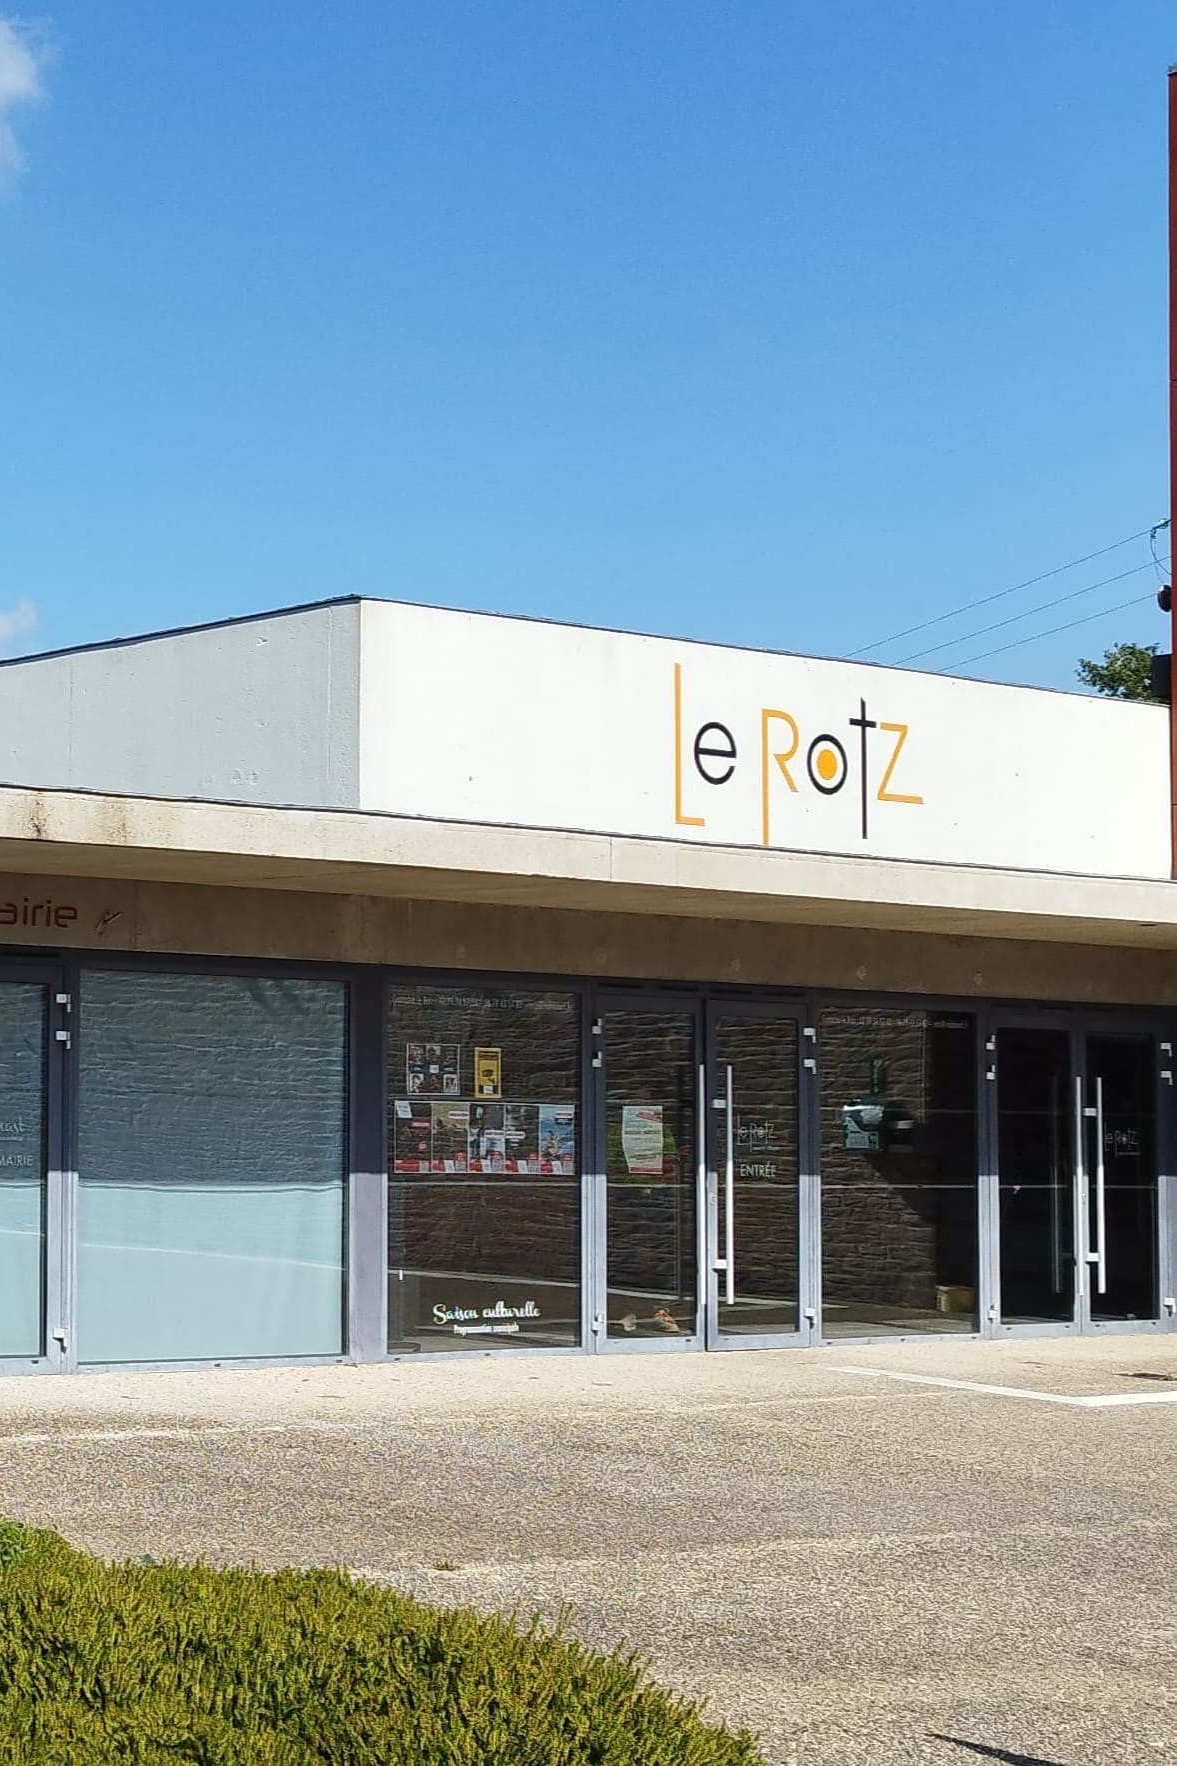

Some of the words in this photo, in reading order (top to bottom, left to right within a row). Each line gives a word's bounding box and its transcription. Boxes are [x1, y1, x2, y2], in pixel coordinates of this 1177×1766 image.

[674, 662, 737, 826] Le
[740, 1160, 777, 1178] ENTRÉE
[432, 1303, 480, 1325] Saison
[482, 1300, 542, 1319] culturelle
